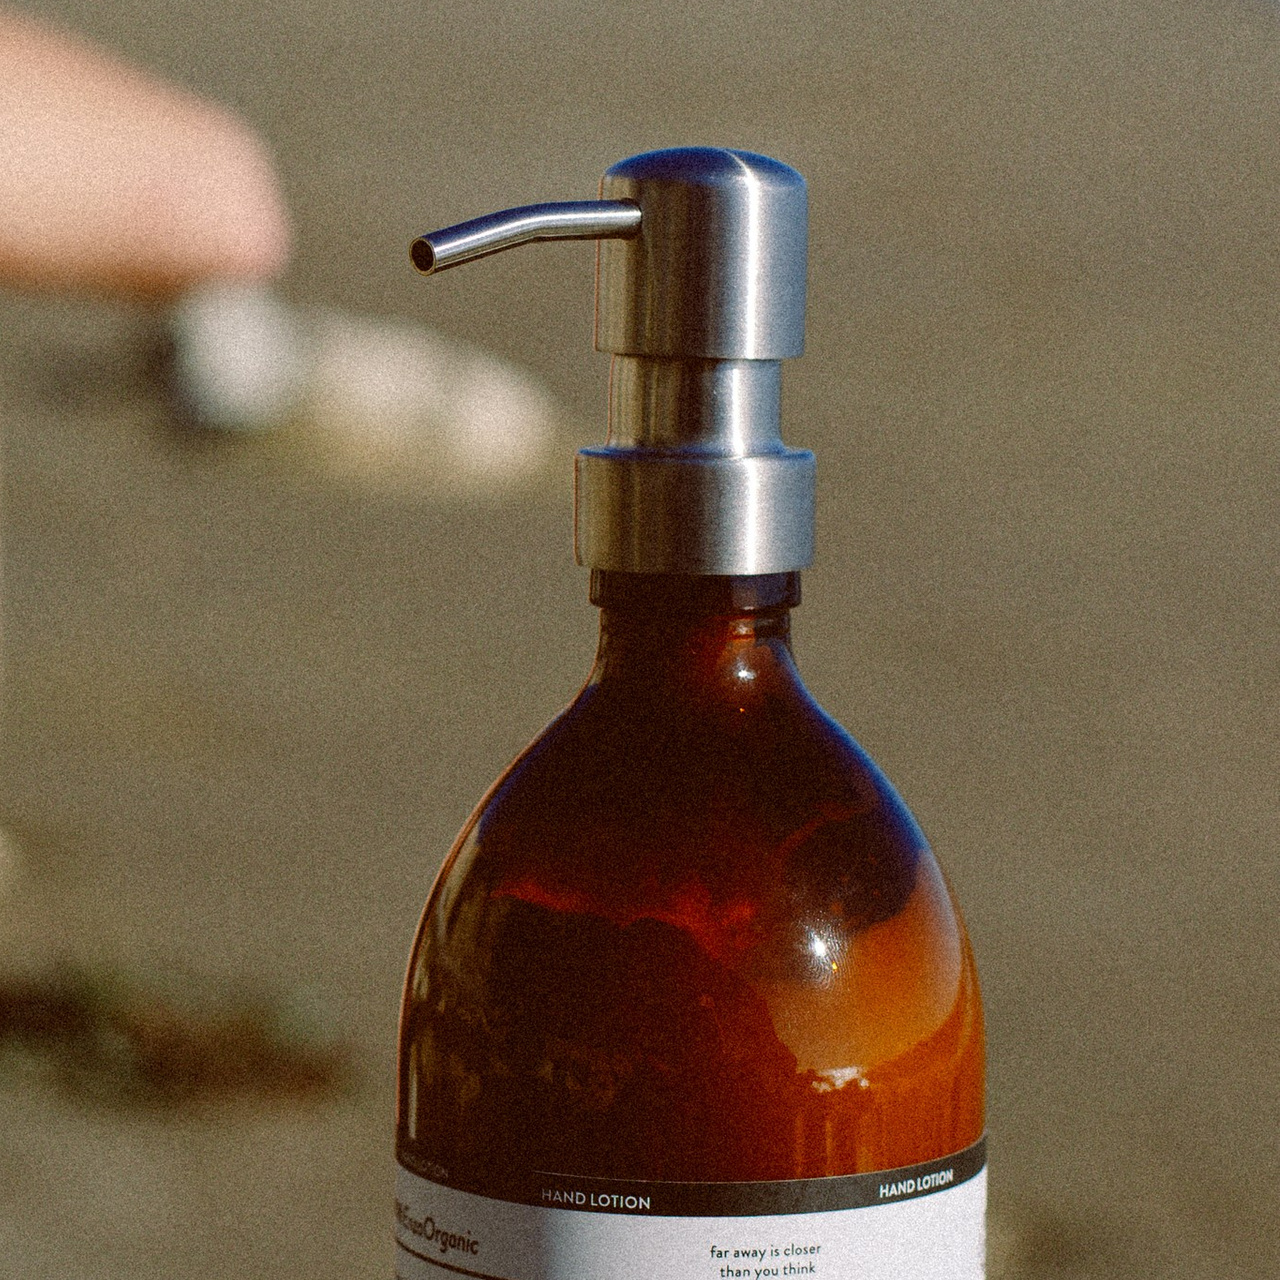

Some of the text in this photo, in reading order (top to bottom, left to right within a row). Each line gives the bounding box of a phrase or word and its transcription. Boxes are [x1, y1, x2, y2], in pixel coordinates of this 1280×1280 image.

[880, 1169, 954, 1199] HAND LOTION
[541, 1187, 651, 1210] HAND LOTION
[710, 1242, 821, 1261] far away is closer
[720, 1261, 816, 1280] than you think
